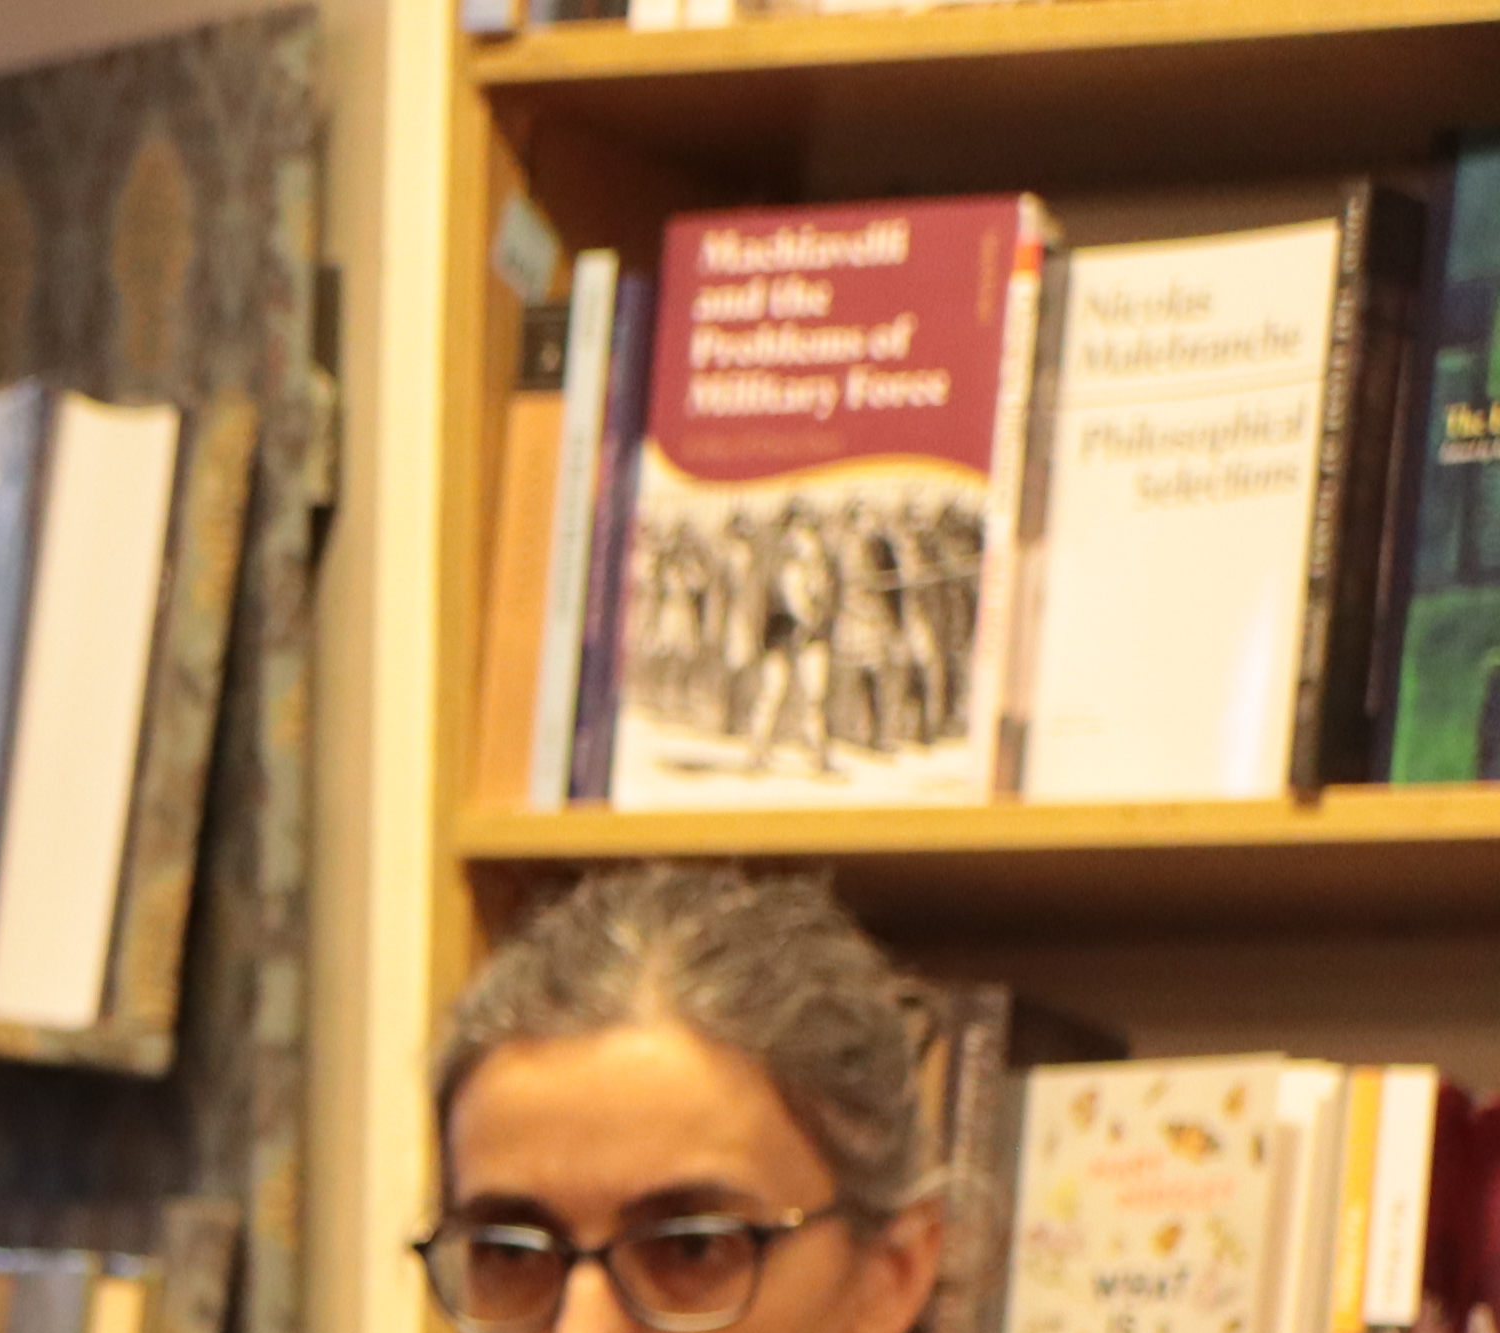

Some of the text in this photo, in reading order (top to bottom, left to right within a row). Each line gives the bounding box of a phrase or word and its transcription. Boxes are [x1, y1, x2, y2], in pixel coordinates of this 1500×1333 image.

[700, 218, 911, 274] Machiavelli
[693, 277, 833, 322] and the
[1080, 289, 1214, 327] Nicolas
[690, 313, 916, 368] Problems of
[1075, 325, 1303, 375] Malebranche
[686, 365, 950, 422] Military Force
[1077, 408, 1306, 463] Philosophical
[1132, 458, 1302, 510] Selections
[1089, 1266, 1191, 1301] WHAT
